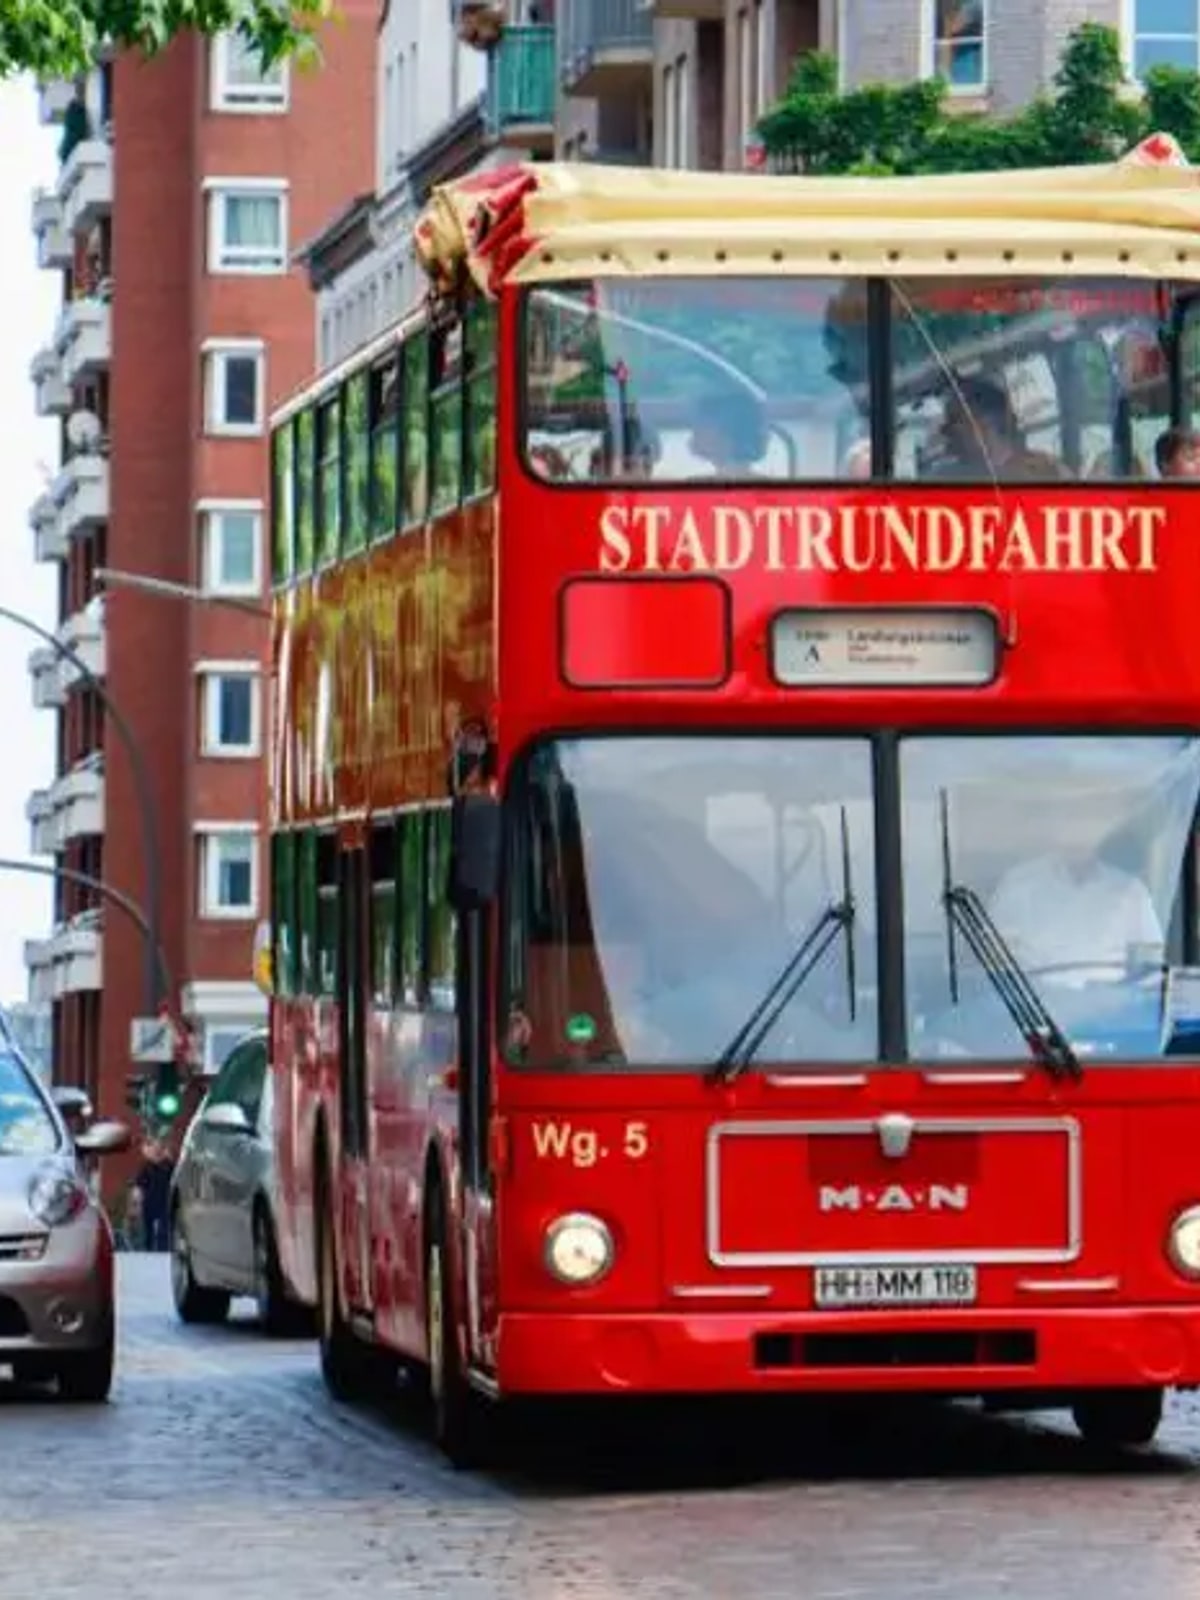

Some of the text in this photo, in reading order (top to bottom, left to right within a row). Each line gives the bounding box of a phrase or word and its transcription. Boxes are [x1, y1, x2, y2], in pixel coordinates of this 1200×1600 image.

[599, 505, 1165, 572] STADTRUNDFAHRT
[531, 1121, 649, 1168] Wg. 5
